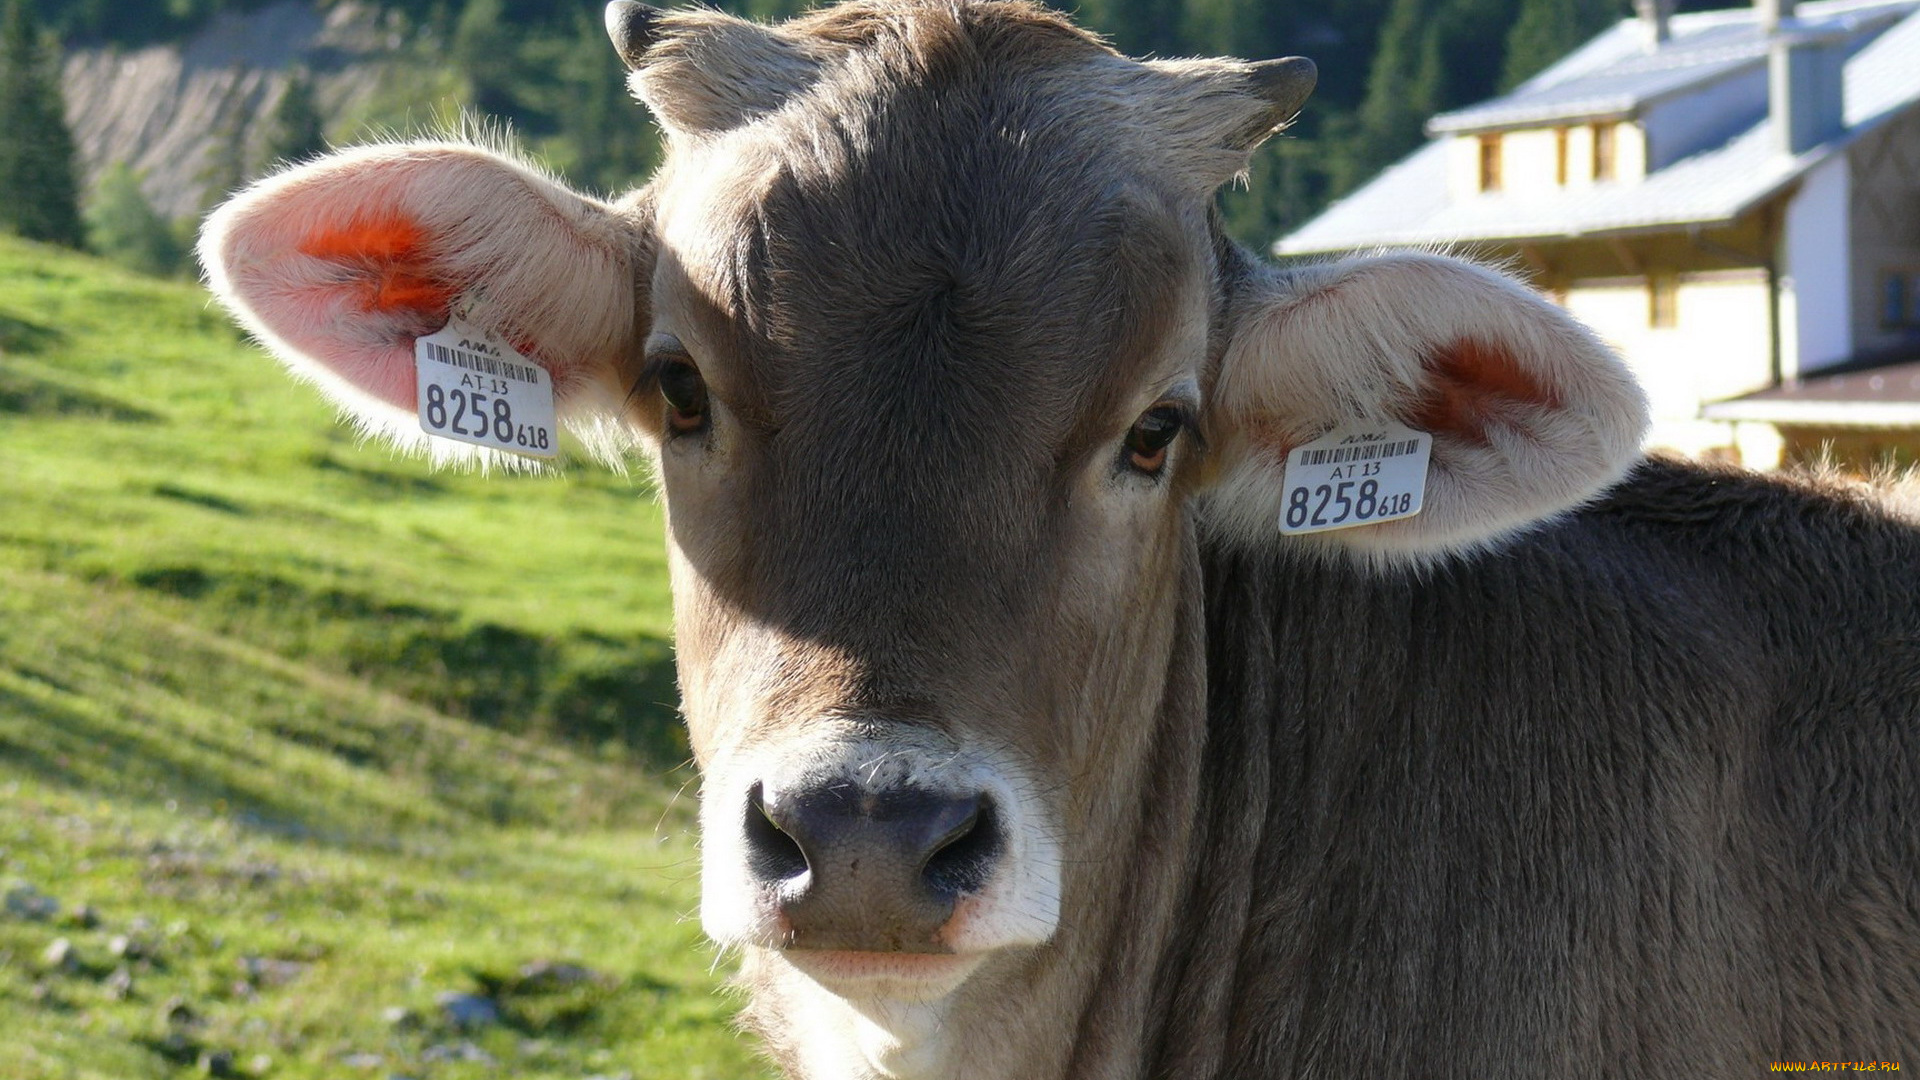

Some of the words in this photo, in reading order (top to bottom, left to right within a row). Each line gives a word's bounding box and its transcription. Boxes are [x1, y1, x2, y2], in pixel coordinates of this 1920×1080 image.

[461, 373, 483, 390] AT
[491, 380, 509, 395] 13
[427, 383, 514, 443] 8258
[517, 424, 549, 449] 618
[1330, 465, 1356, 480] AT
[1362, 461, 1381, 477] 13
[1286, 479, 1379, 528] 8258
[1378, 493, 1411, 517] 618
